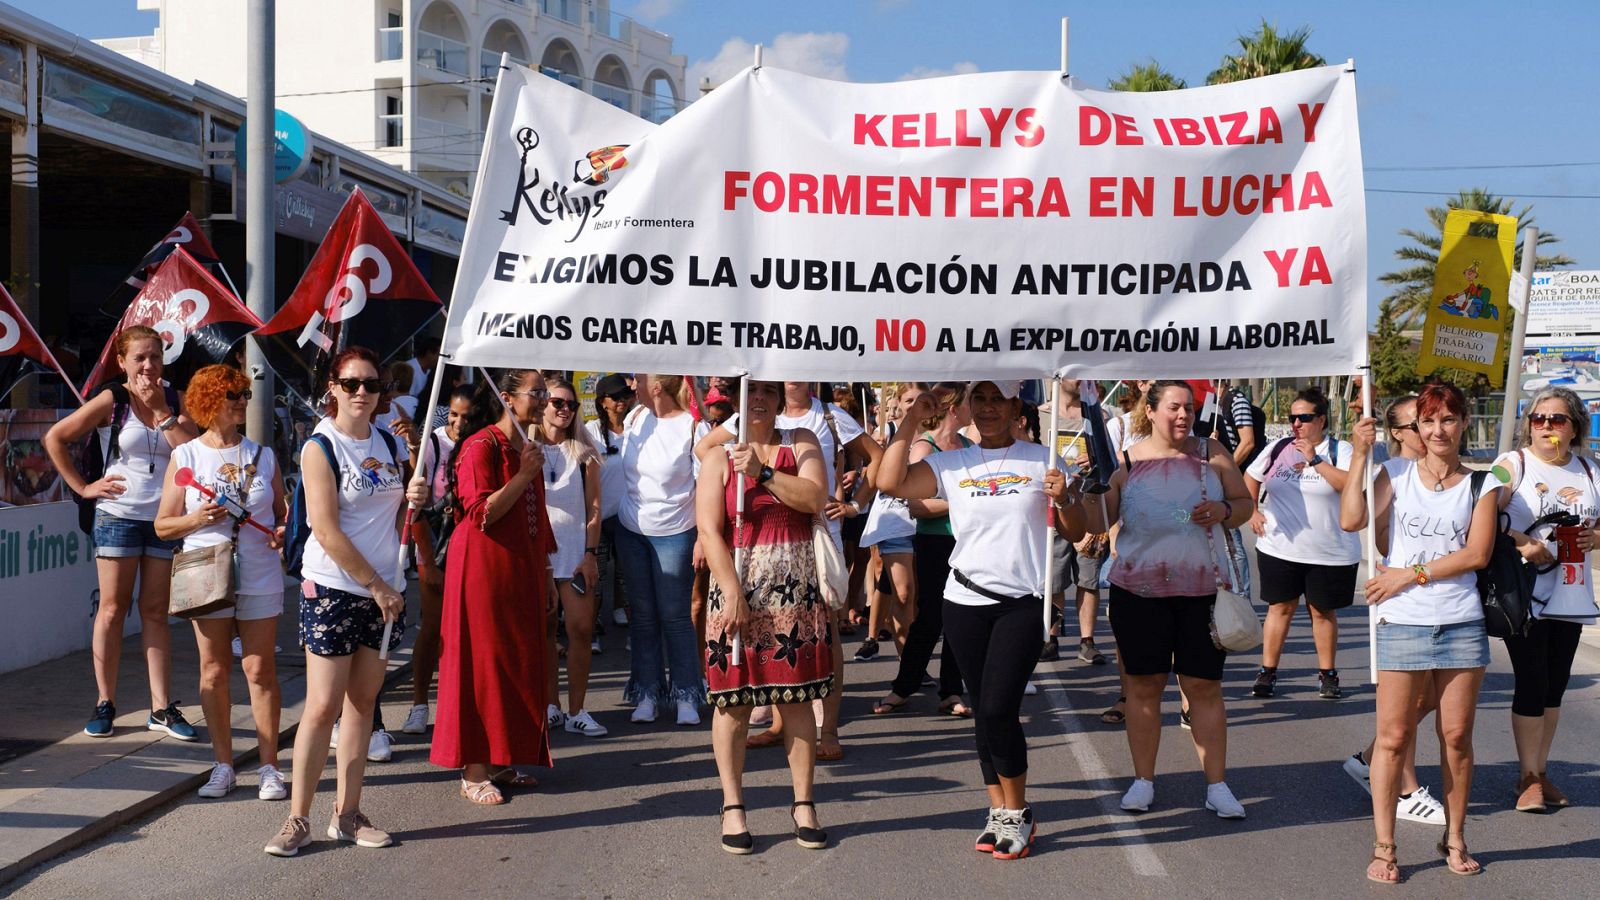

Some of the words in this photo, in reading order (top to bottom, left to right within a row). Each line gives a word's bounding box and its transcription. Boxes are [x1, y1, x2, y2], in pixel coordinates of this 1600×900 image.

[853, 107, 1045, 148] KELLYS
[1079, 105, 1144, 146] DE
[1153, 106, 1283, 146] IBIZA
[1297, 103, 1325, 143] Y
[723, 170, 1071, 218] FORMENTERA
[1089, 176, 1155, 217] EN
[1173, 171, 1333, 217] LUCHA
[594, 221, 613, 231] Ibiza
[614, 218, 621, 229] y
[623, 216, 694, 228] Formentera
[493, 250, 675, 286] EXIGIMOS
[688, 255, 738, 288] LA
[749, 254, 998, 296] JUBILACIÓN
[1011, 260, 1252, 295] ANTICIPADA
[1263, 245, 1333, 288] YA
[1531, 276, 1551, 286] tar
[476, 311, 572, 341] MENOS
[582, 317, 678, 346] CARGA
[687, 320, 723, 346] DE
[729, 321, 866, 357] TRABAJO,
[875, 318, 927, 352] NO
[935, 327, 956, 352] A
[965, 327, 1000, 352] LA
[1009, 321, 1199, 353] EXPLOTACIÓN
[1209, 319, 1335, 351] LABORAL
[1437, 336, 1484, 351] TRABAJO
[1438, 323, 1484, 339] PELIGRO
[1434, 347, 1486, 363] PRECARIO
[27, 524, 79, 574] time
